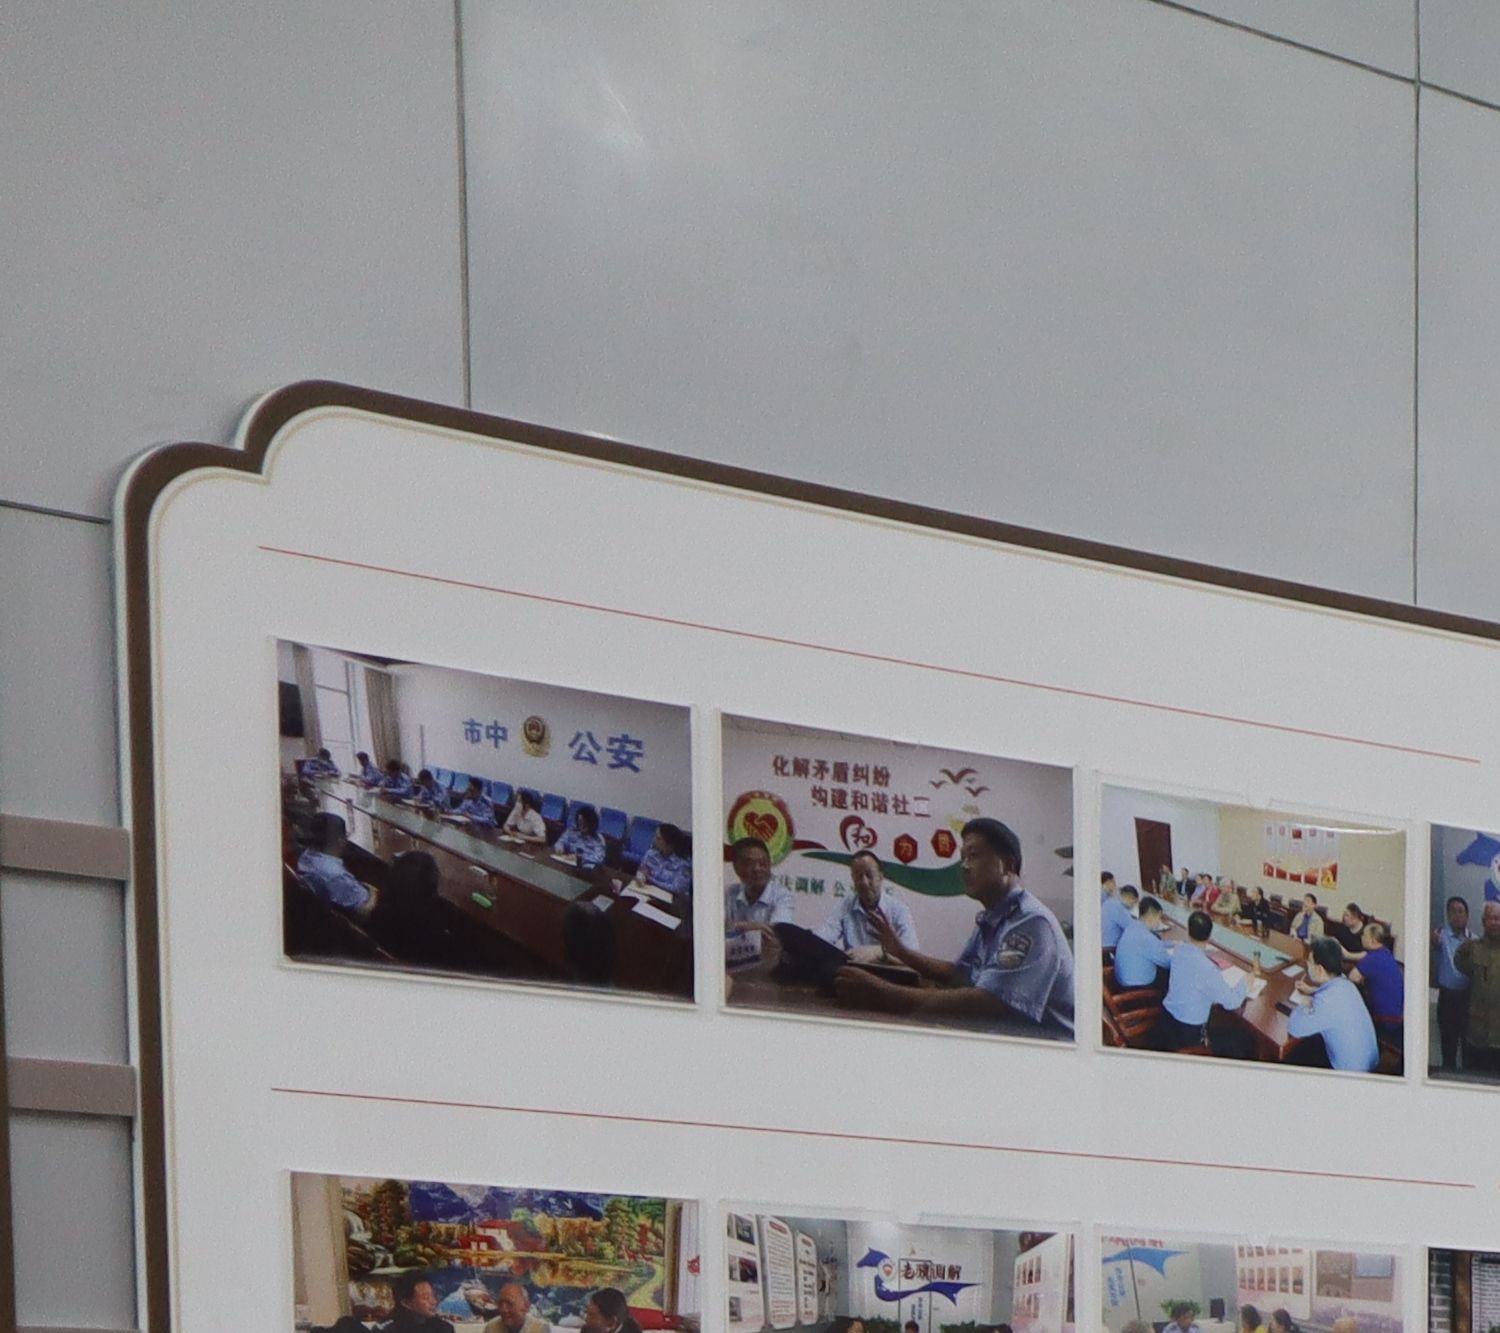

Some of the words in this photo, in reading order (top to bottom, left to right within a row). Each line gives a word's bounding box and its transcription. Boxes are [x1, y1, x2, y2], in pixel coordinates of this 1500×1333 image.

[462, 718, 509, 749] 市中
[568, 731, 645, 773] 公安
[773, 755, 891, 788] 化解矛盾纠纷
